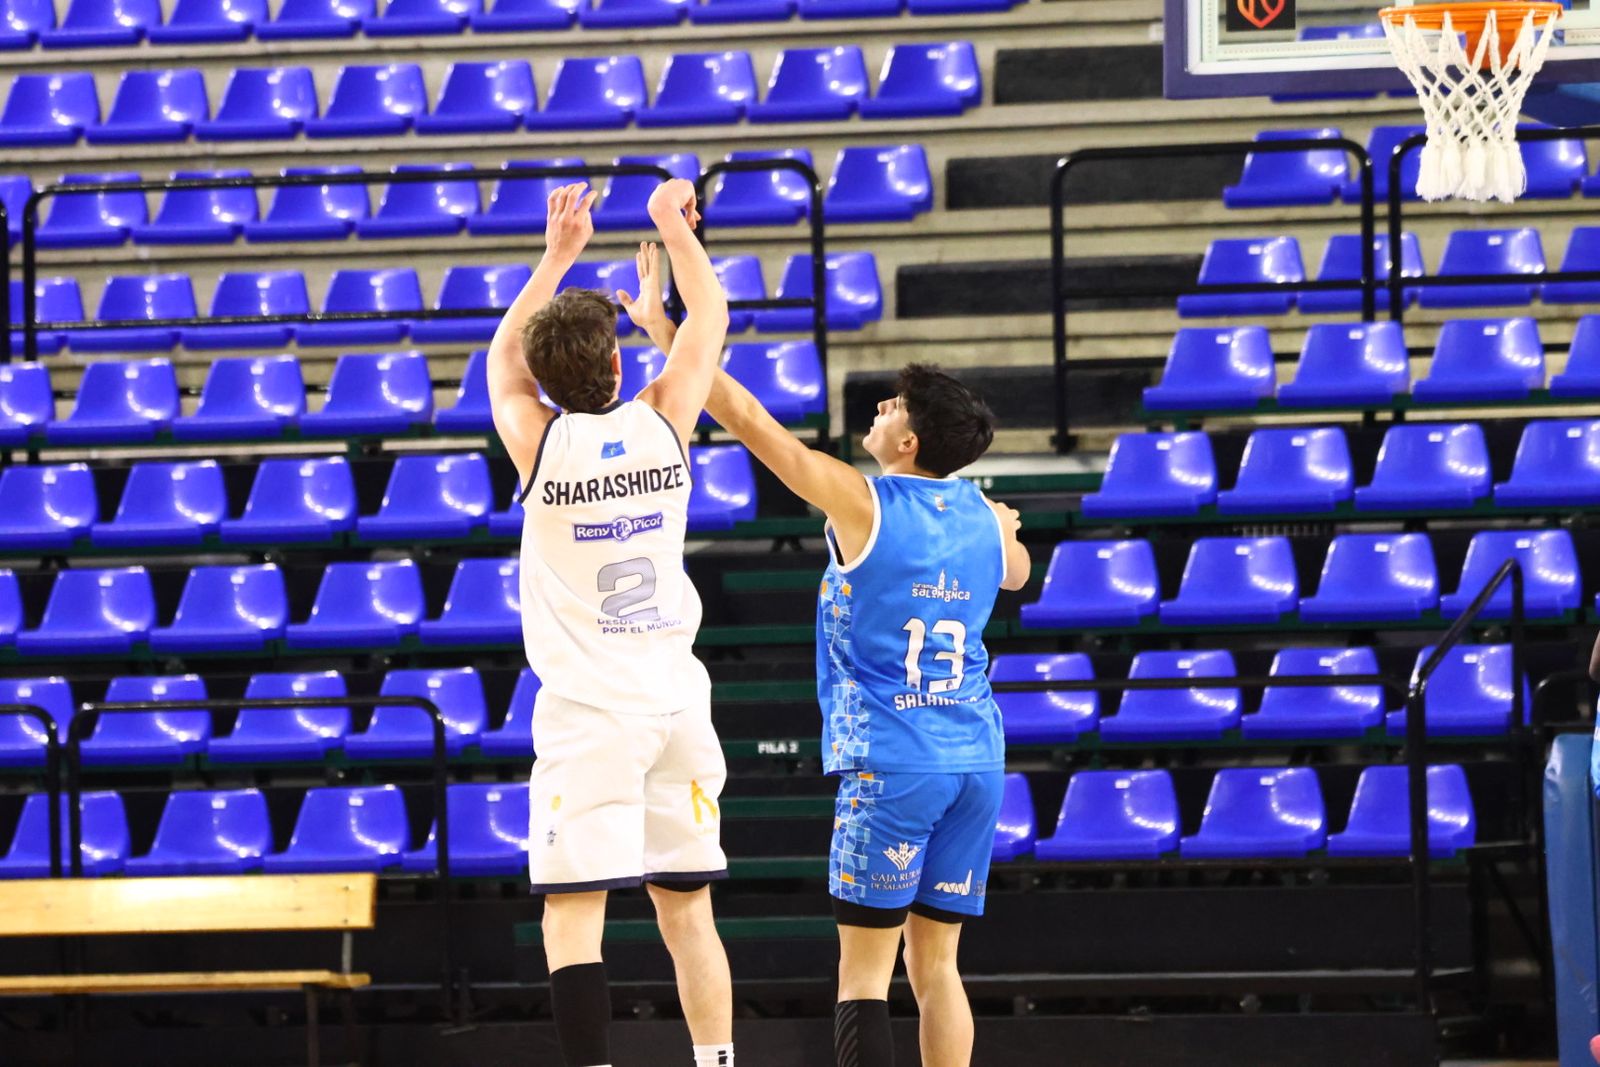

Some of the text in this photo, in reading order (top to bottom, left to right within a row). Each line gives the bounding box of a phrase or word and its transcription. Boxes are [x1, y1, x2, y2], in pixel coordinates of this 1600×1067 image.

[542, 464, 684, 506] SHARASHIDZE
[576, 516, 662, 538] Reny Picot
[597, 556, 657, 621] 2
[602, 626, 626, 634] POR
[630, 626, 644, 634] EL
[902, 617, 967, 694] 13
[758, 741, 800, 754] FILA 2
[871, 873, 897, 885] CAJA
